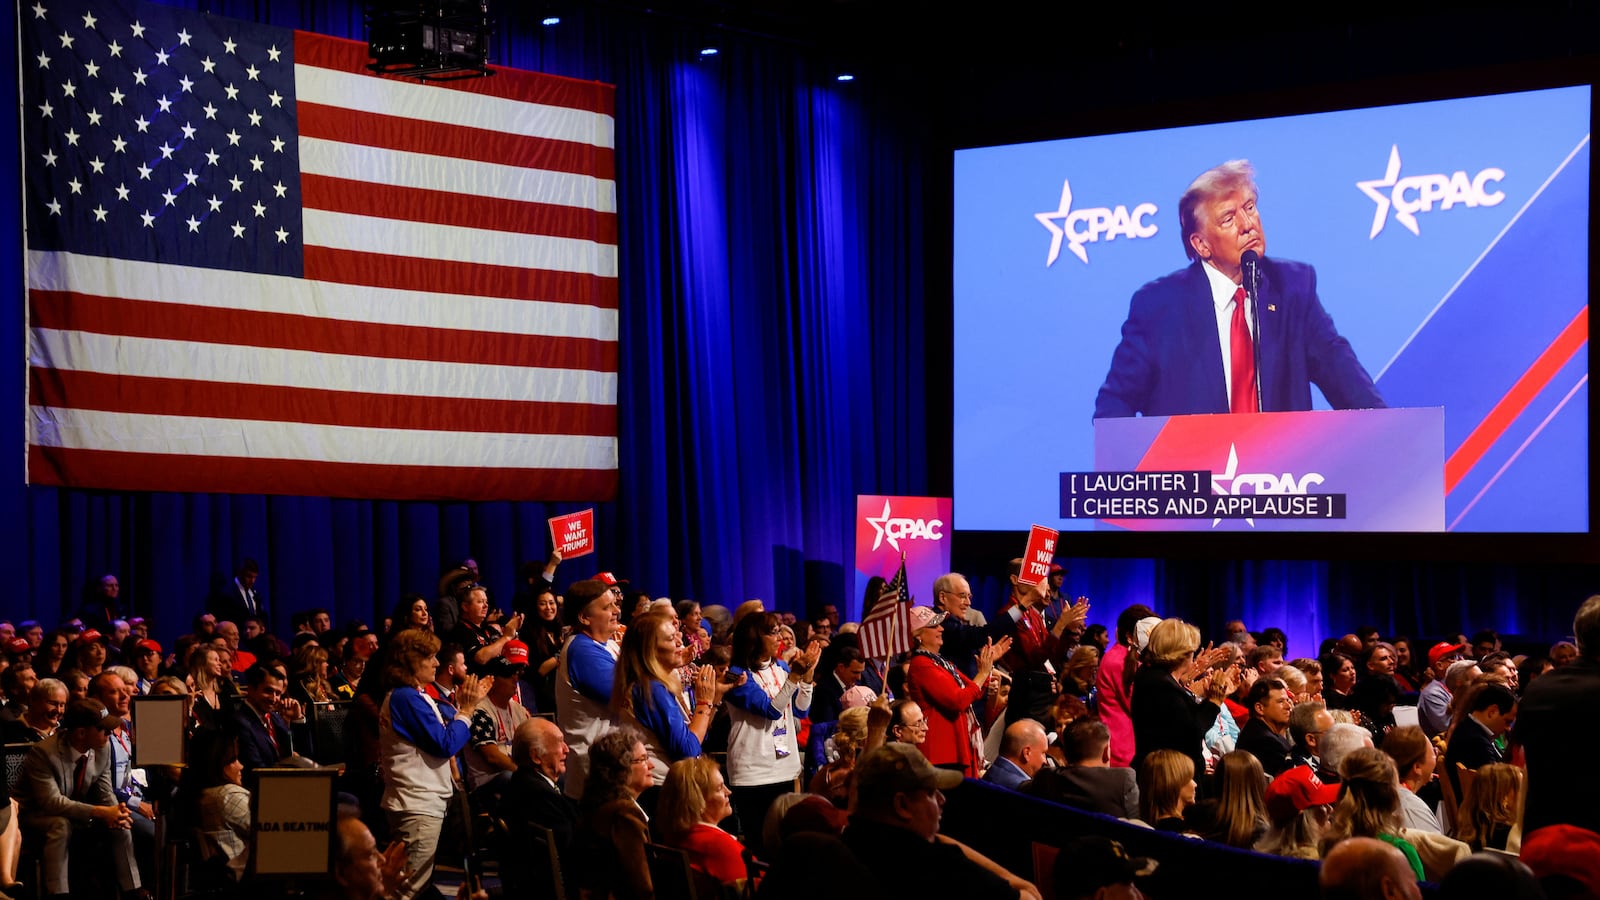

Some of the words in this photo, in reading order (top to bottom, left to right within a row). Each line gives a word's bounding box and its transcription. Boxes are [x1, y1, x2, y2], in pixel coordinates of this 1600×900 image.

[1391, 168, 1505, 214] CPAC
[1065, 202, 1158, 243] CPAC
[1084, 474, 1187, 491] LAUGHTER
[1083, 498, 1159, 515] CHEERS
[1164, 498, 1208, 515] AND
[1213, 497, 1319, 515] APPLAUSE
[568, 520, 582, 531] WE
[885, 518, 943, 540] CPAC
[564, 529, 586, 542] WANT
[562, 538, 588, 552] TRUMP!
[1045, 538, 1054, 551] WE
